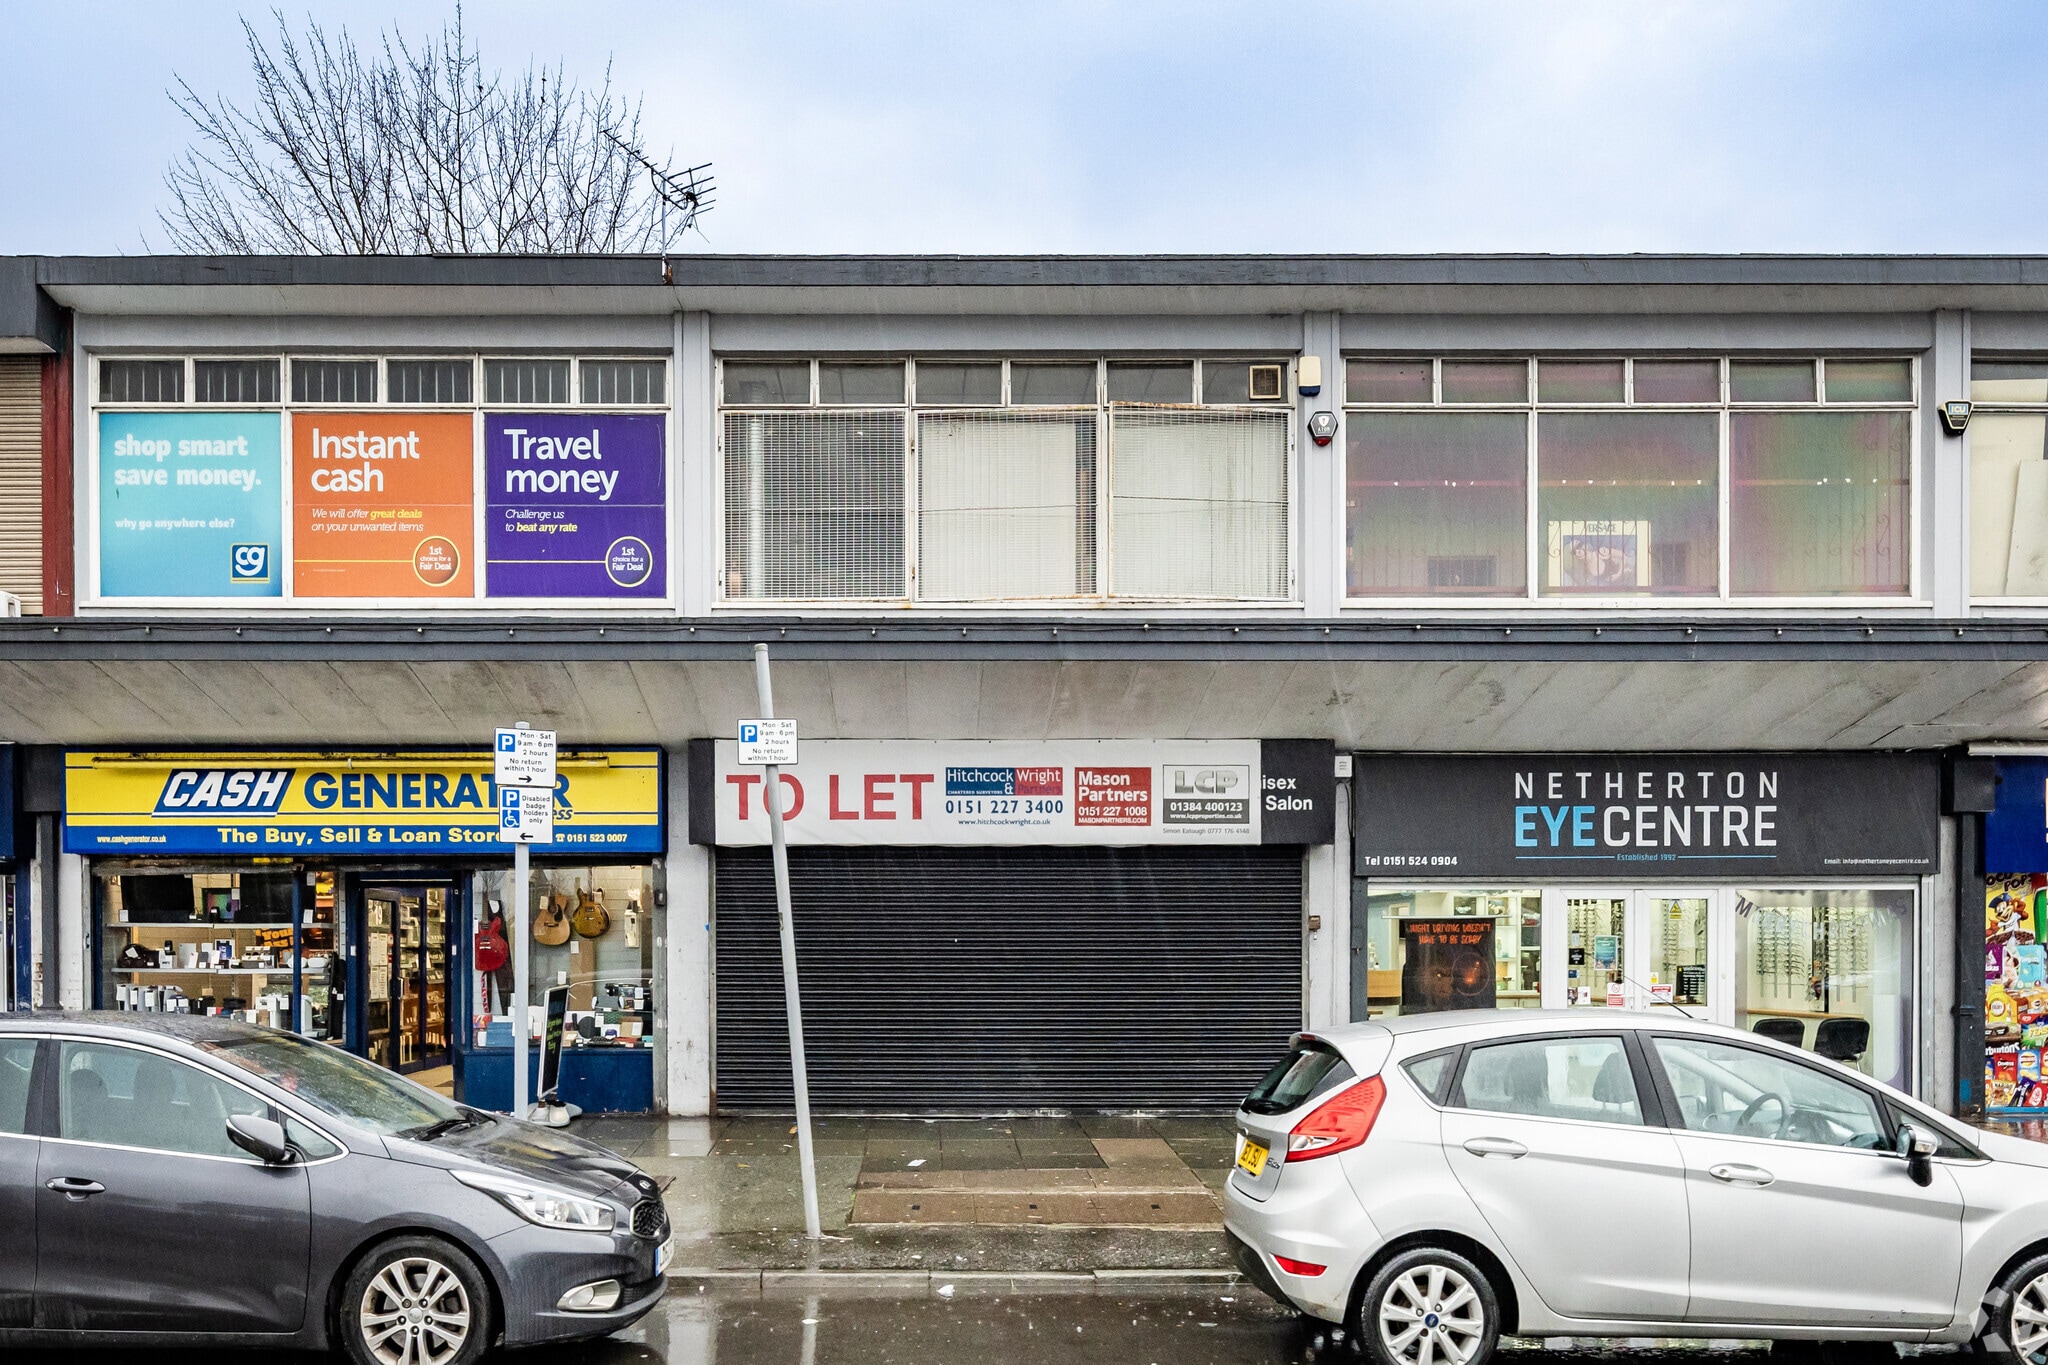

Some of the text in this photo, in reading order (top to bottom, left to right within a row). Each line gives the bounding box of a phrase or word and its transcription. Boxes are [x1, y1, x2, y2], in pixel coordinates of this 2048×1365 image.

[1951, 405, 1966, 413] ICU
[114, 433, 248, 462] shop smart
[312, 428, 420, 460] Instant
[503, 428, 602, 460] Travel
[114, 468, 262, 491] save money.
[311, 462, 384, 493] cash
[505, 469, 619, 501] money
[312, 508, 422, 520] We will offer great deals
[505, 509, 565, 521] Challenge us
[115, 518, 235, 530] why go anywhere else?
[311, 522, 424, 533] on your unwanted items
[505, 522, 578, 534] to beat any rate
[429, 546, 442, 555] 1st
[621, 546, 635, 556] 1st
[234, 546, 265, 577] cg
[420, 562, 452, 570] Fair Deal
[612, 563, 644, 571] Fair Deal
[744, 726, 755, 742] P
[501, 735, 513, 751] P
[946, 769, 1061, 785] Hitchcock Wright
[1078, 771, 1131, 785] Mason
[1175, 770, 1239, 794] LCP
[1262, 775, 1297, 790] isex
[162, 771, 573, 809] CASH GENERATR
[1004, 782, 1014, 795] &
[1515, 771, 1778, 799] NETHERTON
[506, 791, 517, 807] P
[521, 795, 550, 803] Disabled
[726, 773, 935, 822] TO LET
[1078, 786, 1148, 802] Partners
[946, 800, 1063, 814] 0151 227 3400
[1170, 802, 1243, 811] 01384 400123
[1265, 795, 1313, 811] Salon
[1078, 806, 1147, 816] 0151 227 1008
[958, 818, 1051, 827] www.hitchcockwright.co.uk
[97, 834, 167, 845] www.cashgenerator.co.uk
[217, 828, 258, 843] The
[265, 828, 313, 846] Buy,
[320, 827, 361, 843] Sell
[366, 828, 383, 843] &
[388, 827, 441, 843] Loan
[567, 834, 628, 843] 0151 523 0007
[1364, 856, 1458, 866] Tel 0151 524 0904
[1616, 853, 1676, 861] Established 1992
[1409, 923, 1491, 933] NIGHT DRIVING DOESN'T
[1418, 935, 1482, 945] HAVE TO BE SCARY
[2029, 1026, 2048, 1037] FEAS
[1985, 1042, 2020, 1056] rburtons
